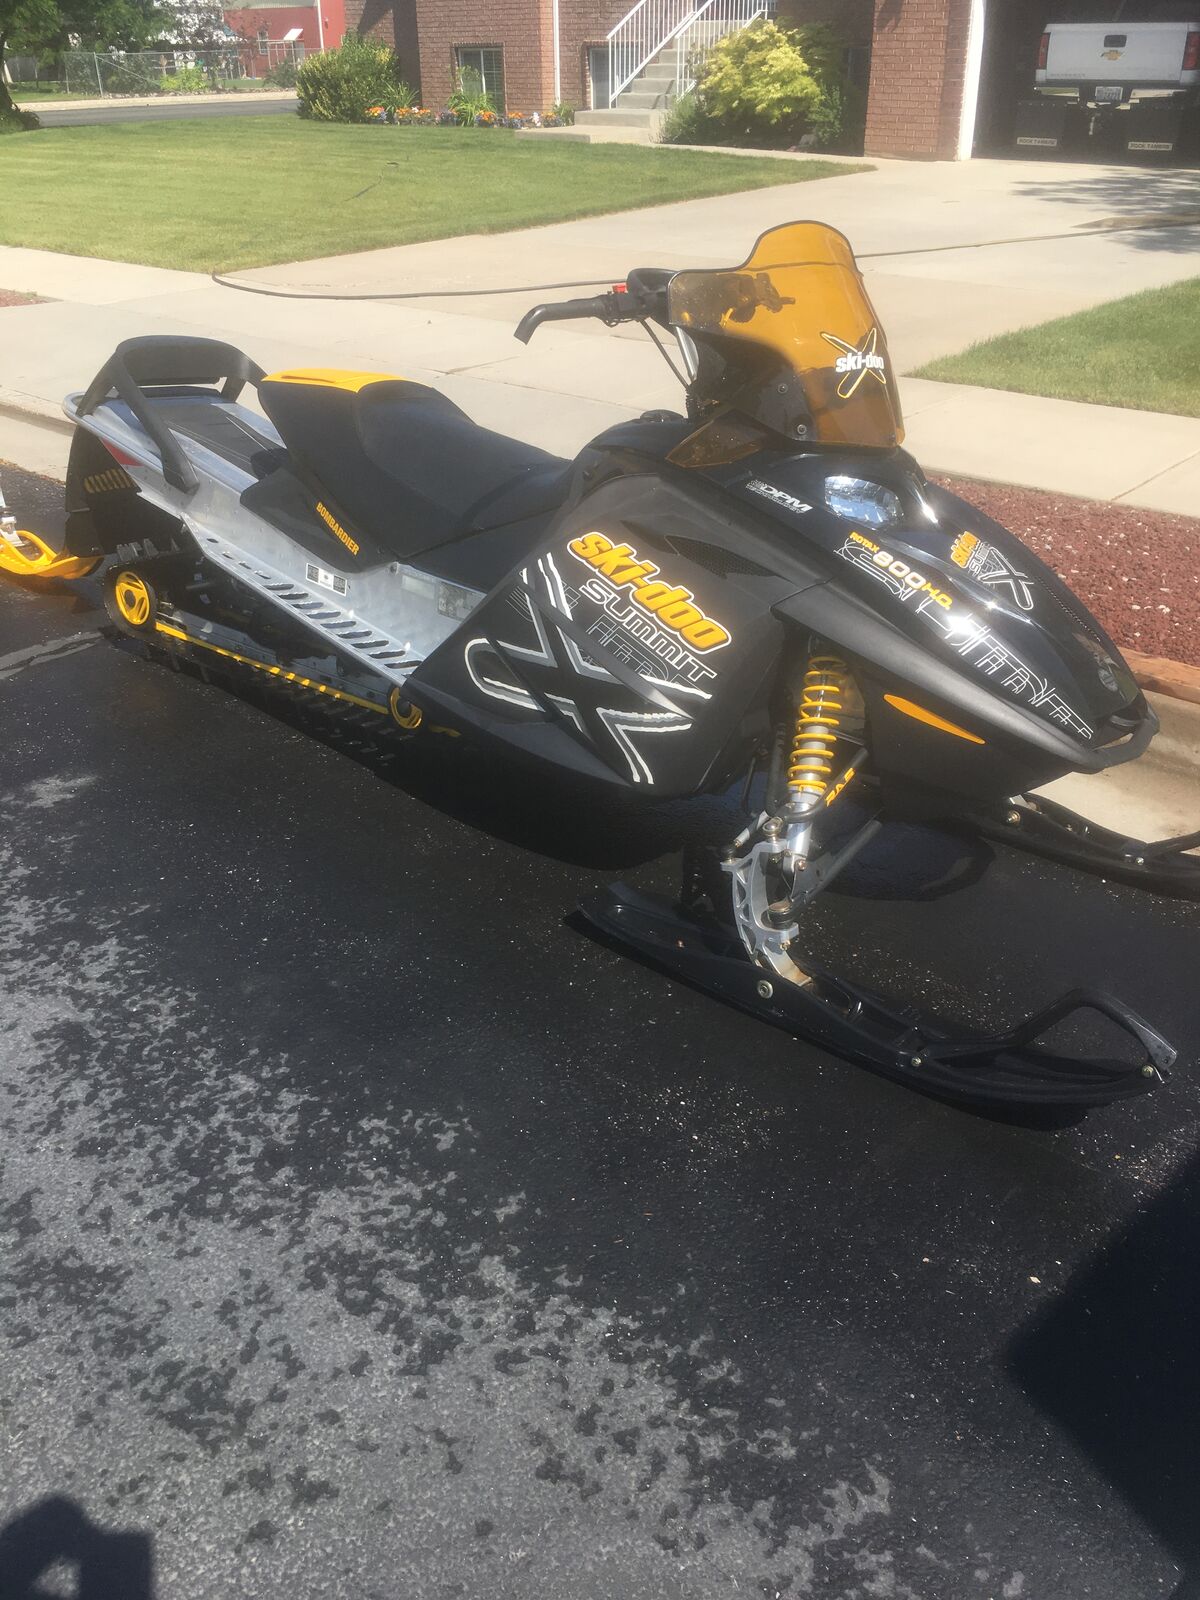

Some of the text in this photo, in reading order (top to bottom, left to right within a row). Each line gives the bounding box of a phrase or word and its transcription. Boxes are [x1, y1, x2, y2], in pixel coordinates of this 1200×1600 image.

[316, 501, 360, 556] BOMBARDIER
[849, 531, 880, 553] ROTAX
[567, 532, 731, 654] ski-doo
[579, 579, 717, 682] SUMMIT
